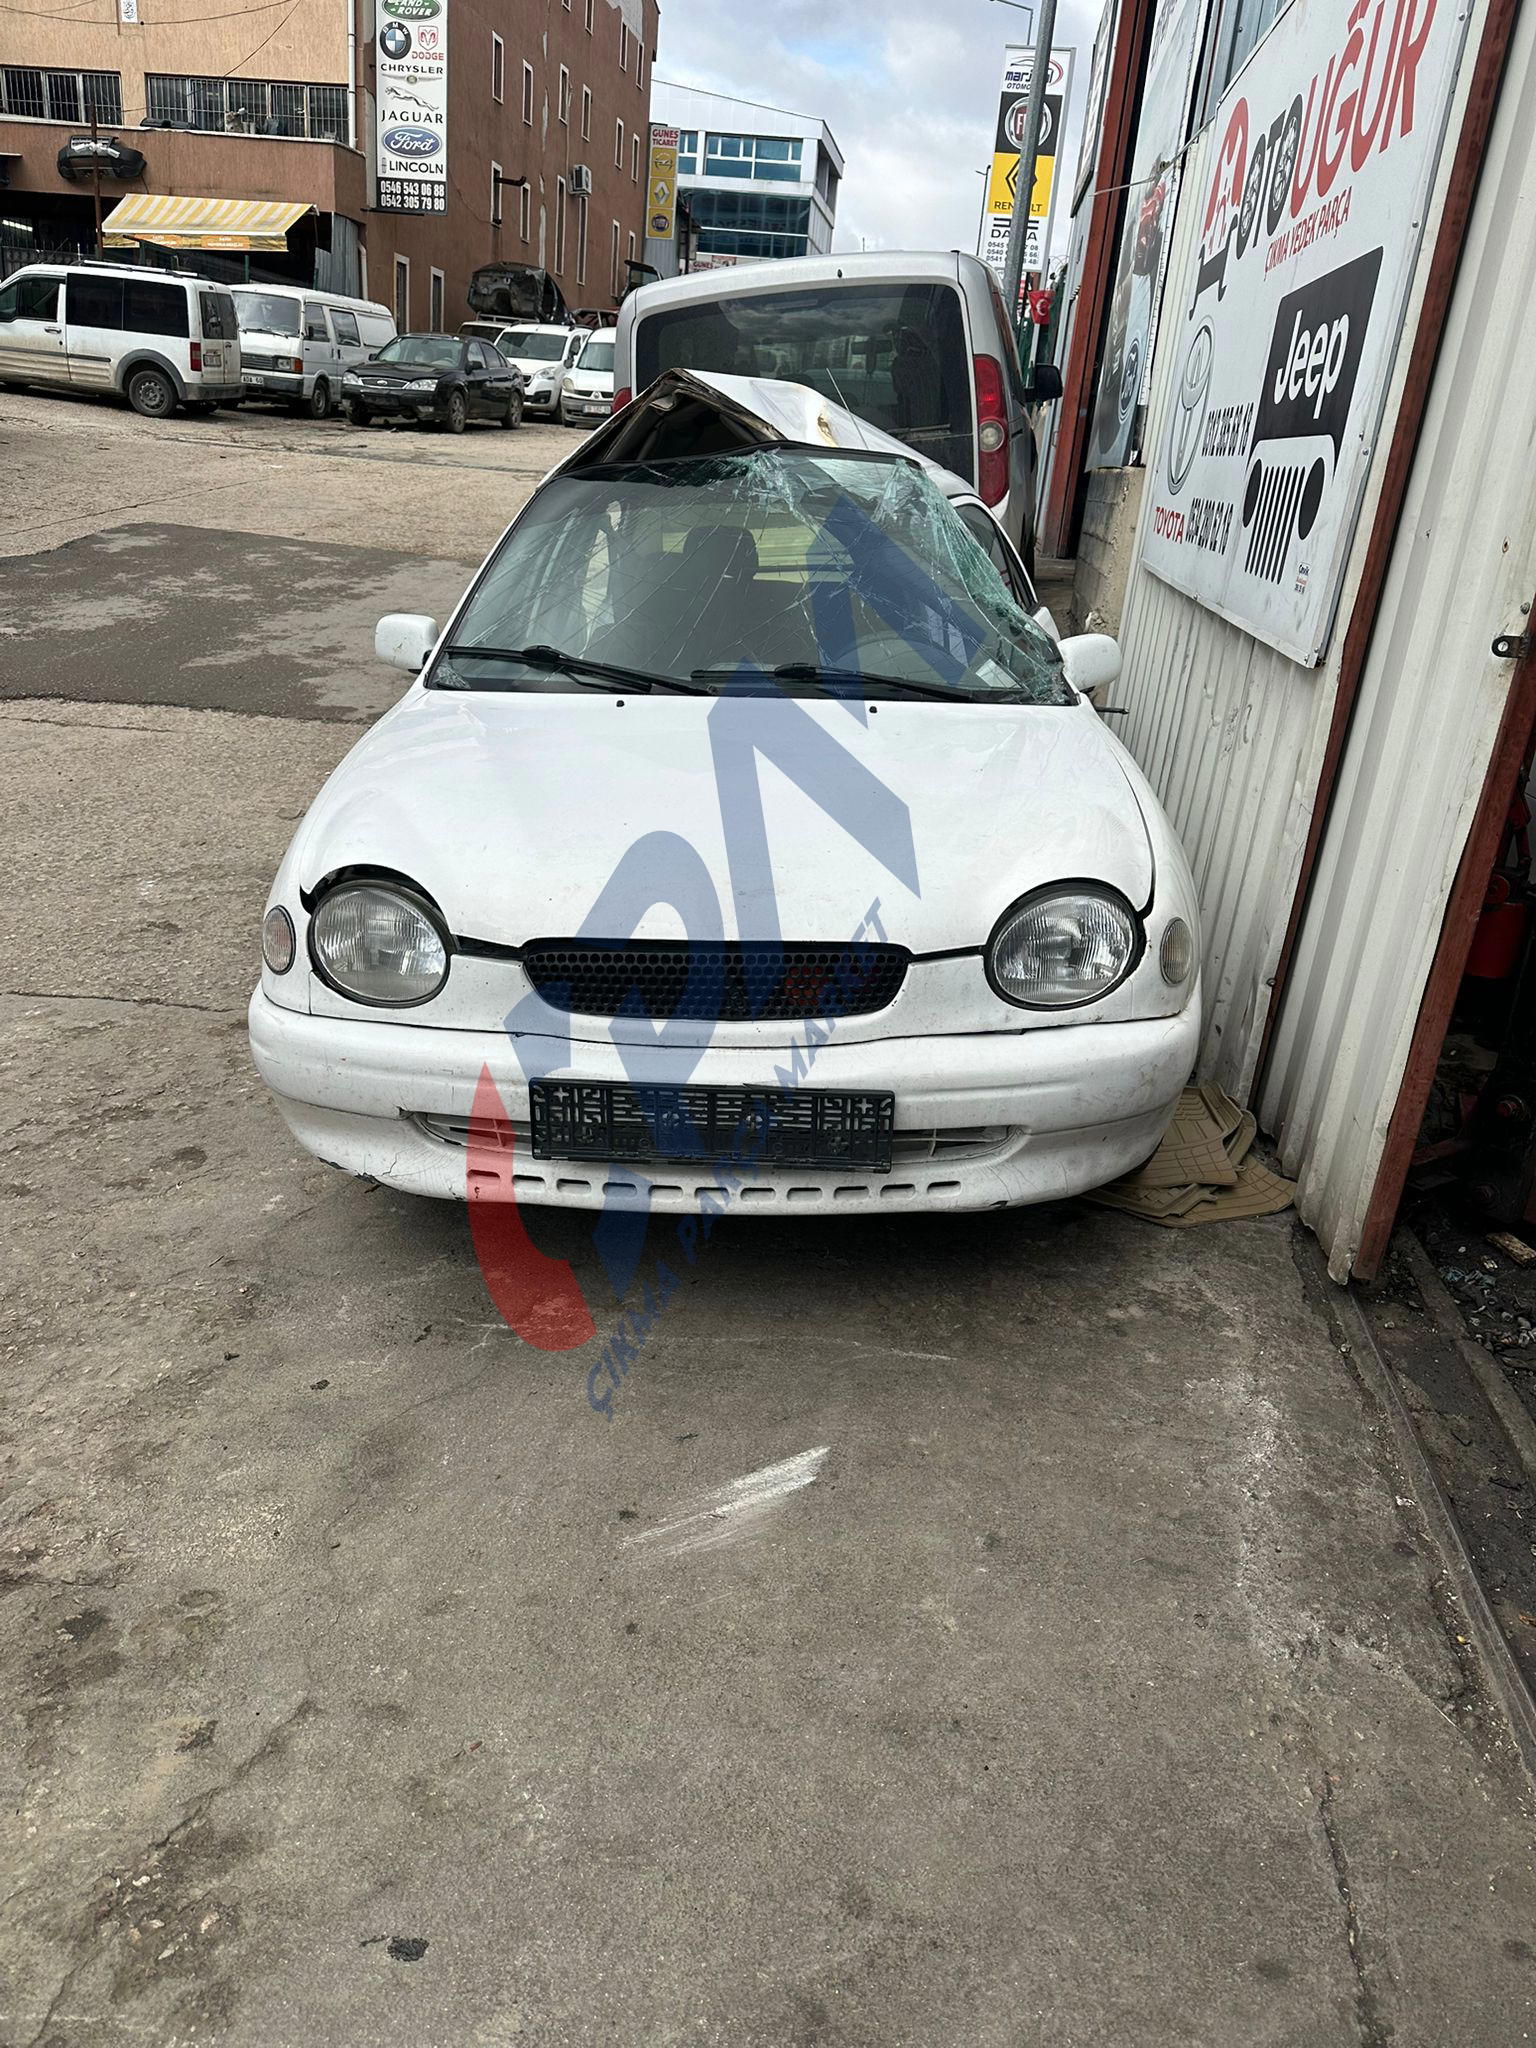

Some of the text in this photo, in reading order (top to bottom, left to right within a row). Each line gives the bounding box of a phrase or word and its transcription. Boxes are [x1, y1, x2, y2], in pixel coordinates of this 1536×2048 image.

[397, 6, 433, 16] ROVER
[411, 51, 445, 61] DODGE
[380, 63, 443, 75] CHRYSLER
[381, 110, 443, 124] JAGUAR
[391, 131, 435, 152] Ford
[389, 160, 444, 175] LINCOLN
[380, 180, 445, 198] 0546 543 06 88
[380, 193, 445, 212] 0542 305 79 80
[994, 200, 1043, 213] RENLT
[1288, 208, 1321, 256] YEDEK
[1315, 185, 1352, 239] PARÇA
[1273, 310, 1350, 420] Jeep
[1153, 506, 1185, 544] TOYOTA
